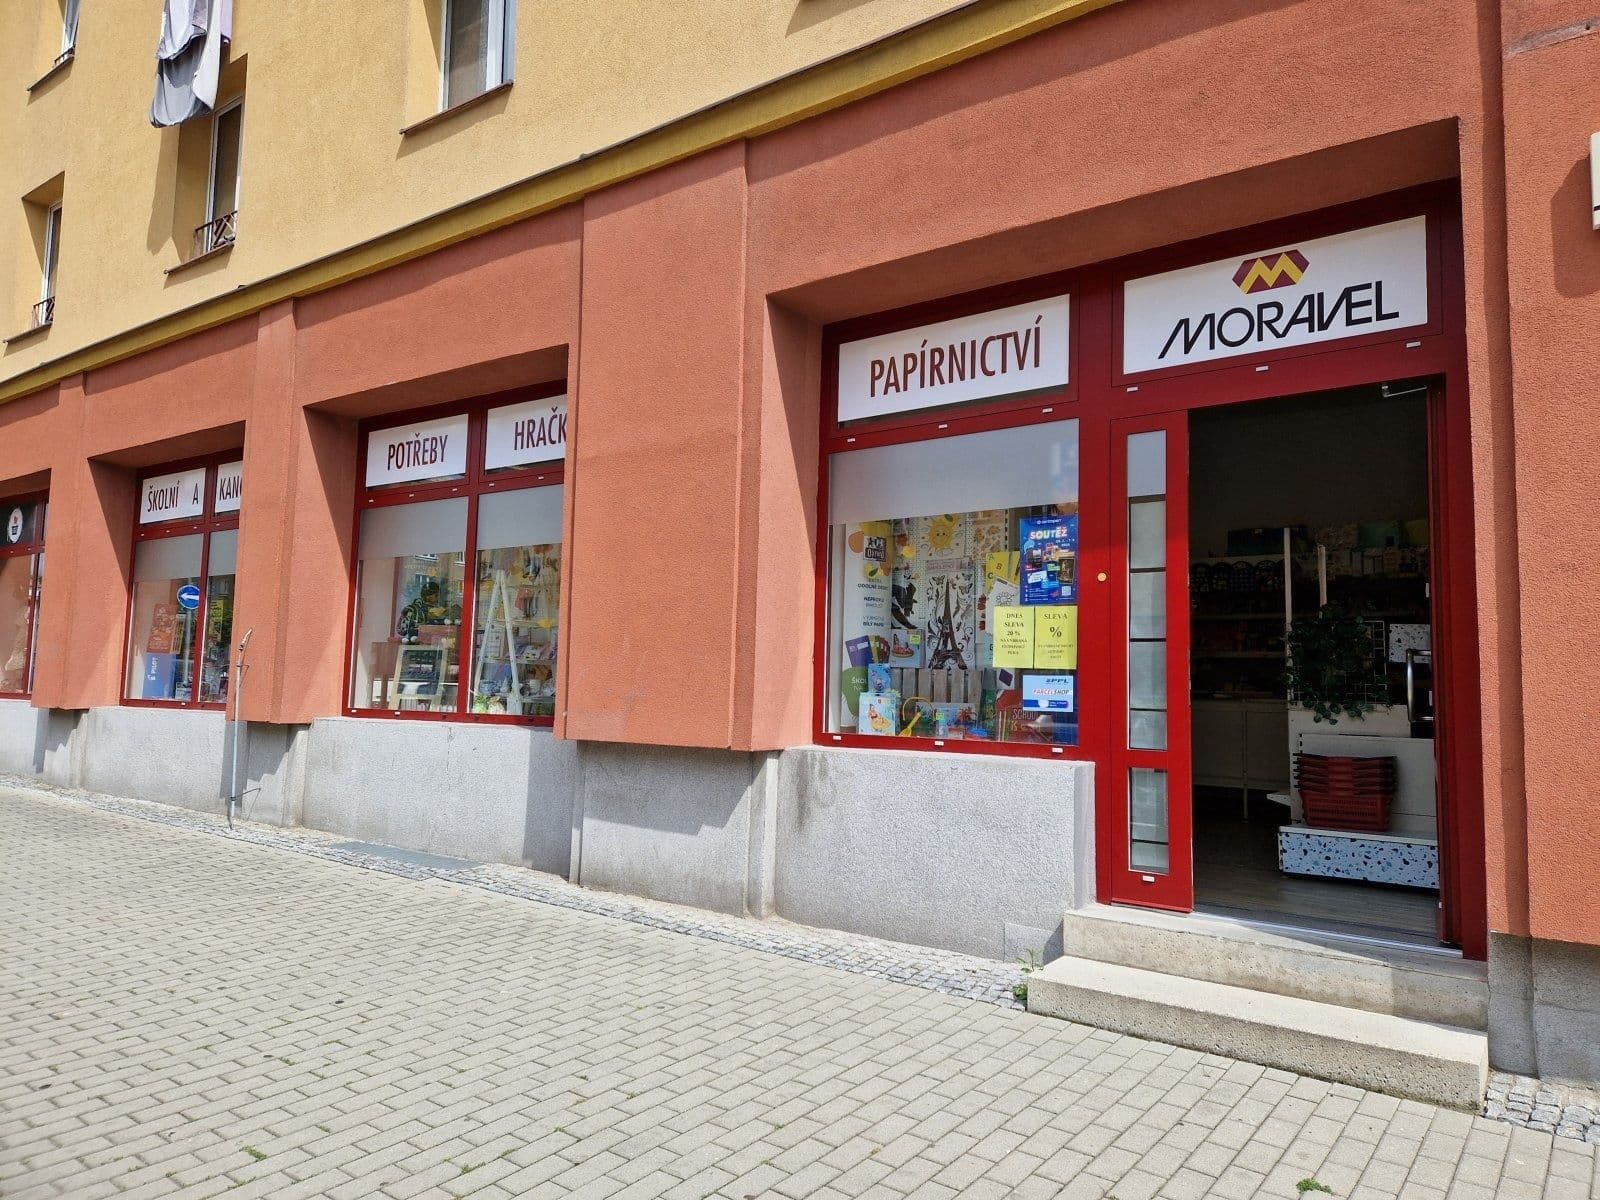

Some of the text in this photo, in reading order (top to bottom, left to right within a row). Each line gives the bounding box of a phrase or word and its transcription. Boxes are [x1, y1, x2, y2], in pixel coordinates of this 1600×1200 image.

[1157, 280, 1400, 360] MORAVEL
[870, 314, 1043, 398] PAPÍRNICTVÍ
[513, 406, 567, 451] HRAČK
[387, 432, 449, 471] POTŘEBY
[147, 480, 199, 512] ŠKOLNÍ A
[219, 475, 243, 501] KAN
[1030, 526, 1068, 540] SOUTĚŽ
[1049, 626, 1062, 638] %
